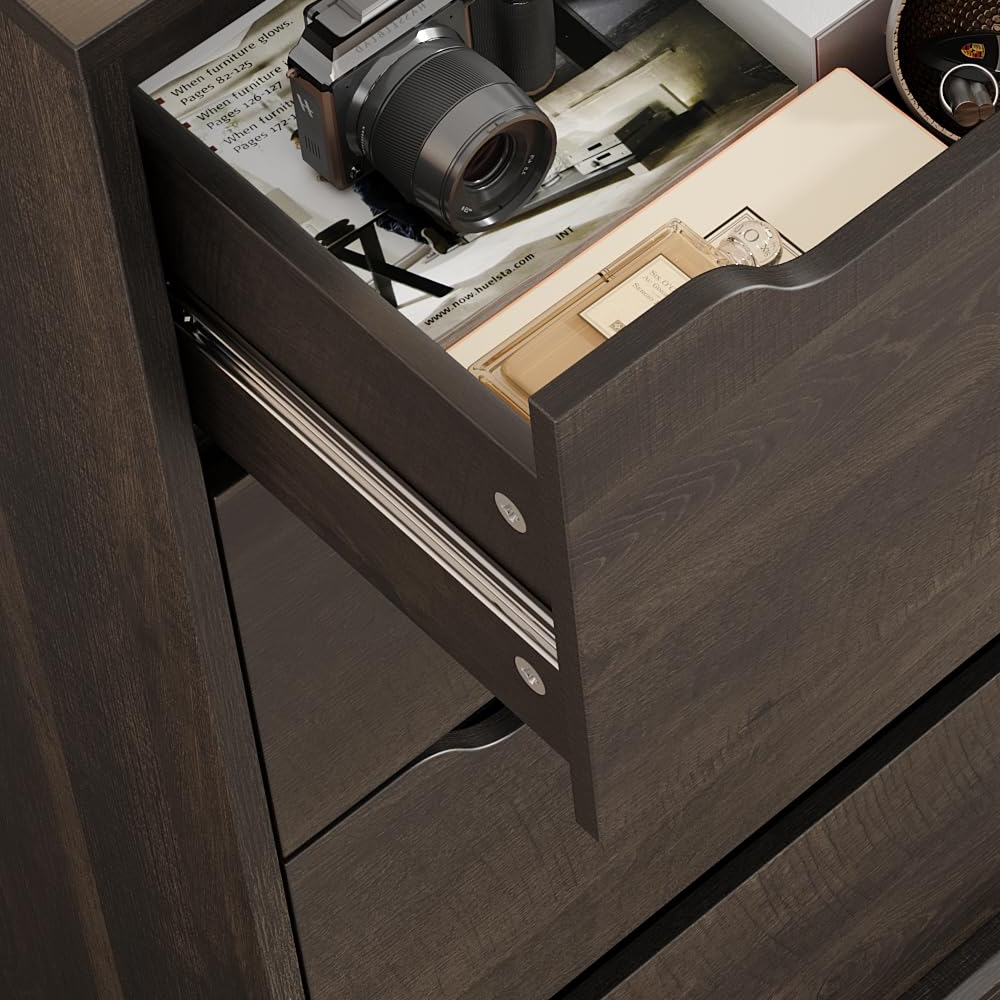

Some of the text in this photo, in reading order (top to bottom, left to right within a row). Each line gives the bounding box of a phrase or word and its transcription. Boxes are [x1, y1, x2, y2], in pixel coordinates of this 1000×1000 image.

[170, 20, 294, 97] When furniture glows.
[180, 60, 253, 106] Pages 82-125
[196, 66, 282, 121] When furniture
[206, 81, 283, 130] Pages 126-127
[223, 123, 258, 145] When
[233, 114, 297, 154] Pages 172-1
[555, 226, 575, 241] INT
[424, 252, 535, 326] www.now.huelsta.com
